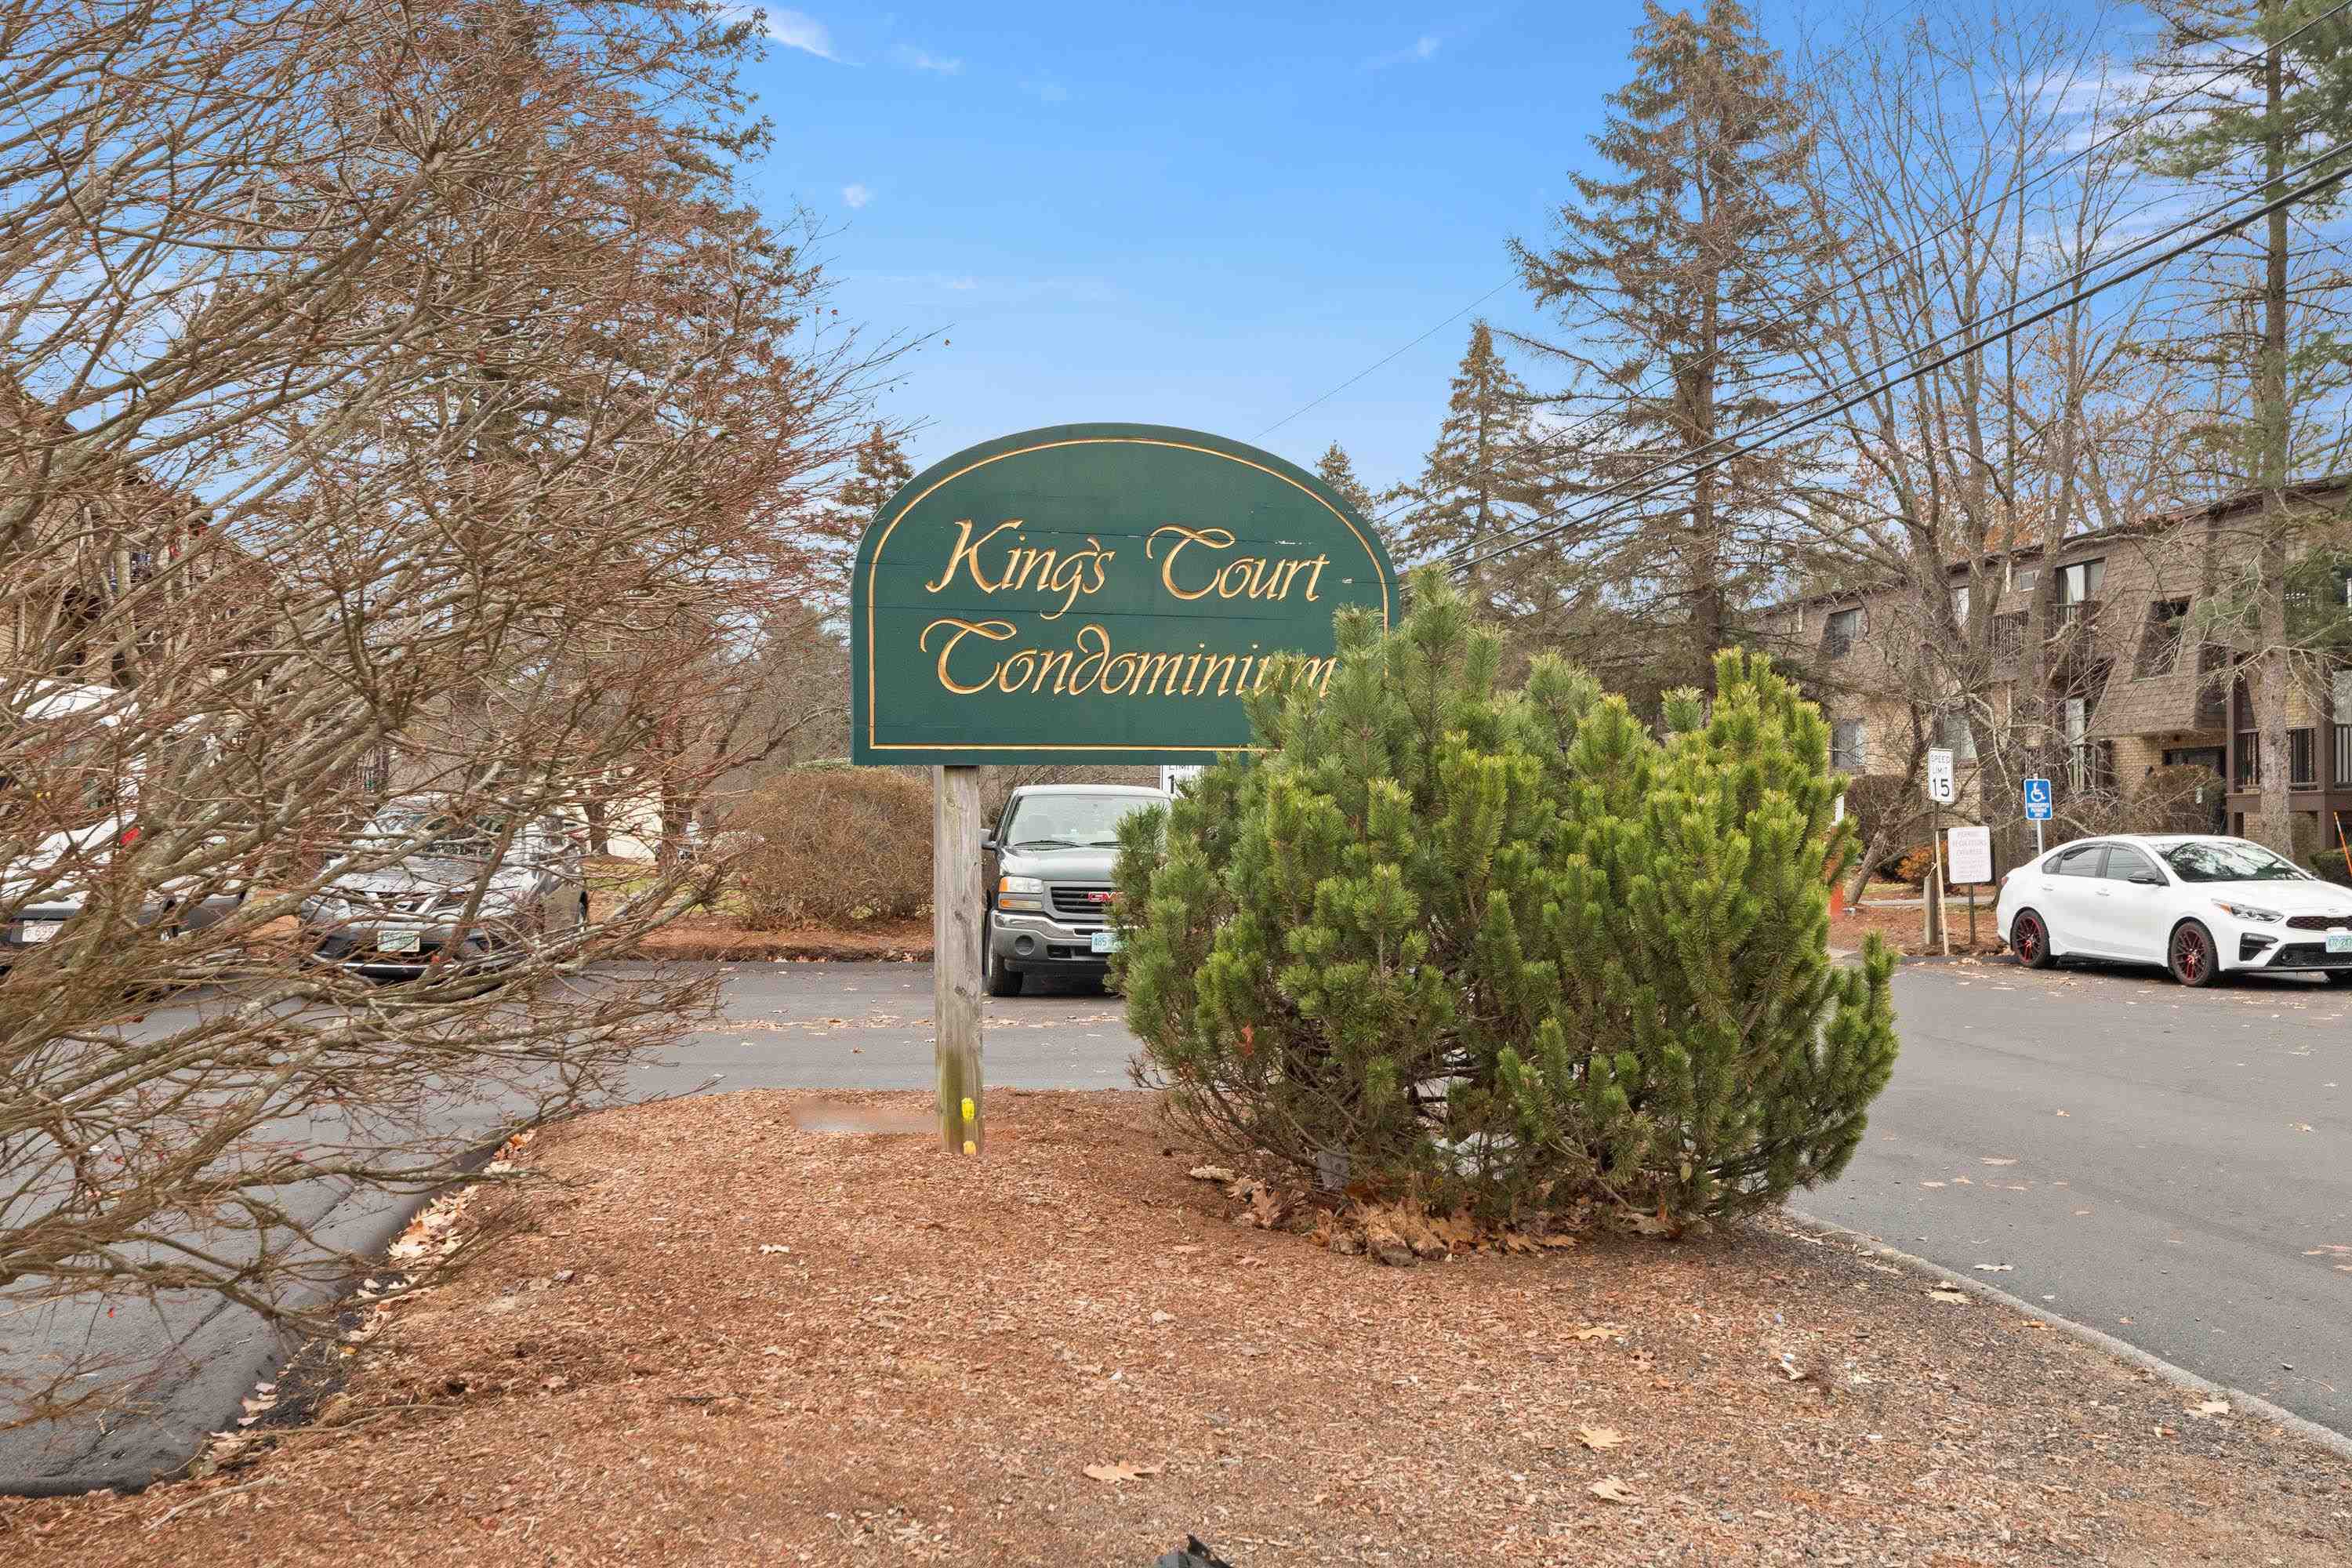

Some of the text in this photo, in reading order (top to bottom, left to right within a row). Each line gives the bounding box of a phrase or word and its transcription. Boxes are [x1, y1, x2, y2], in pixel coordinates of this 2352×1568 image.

[925, 518, 1331, 620] King's Court
[1930, 753, 1951, 764] SPEED
[1932, 764, 1948, 775] LIMIT
[1932, 777, 1951, 797] 15
